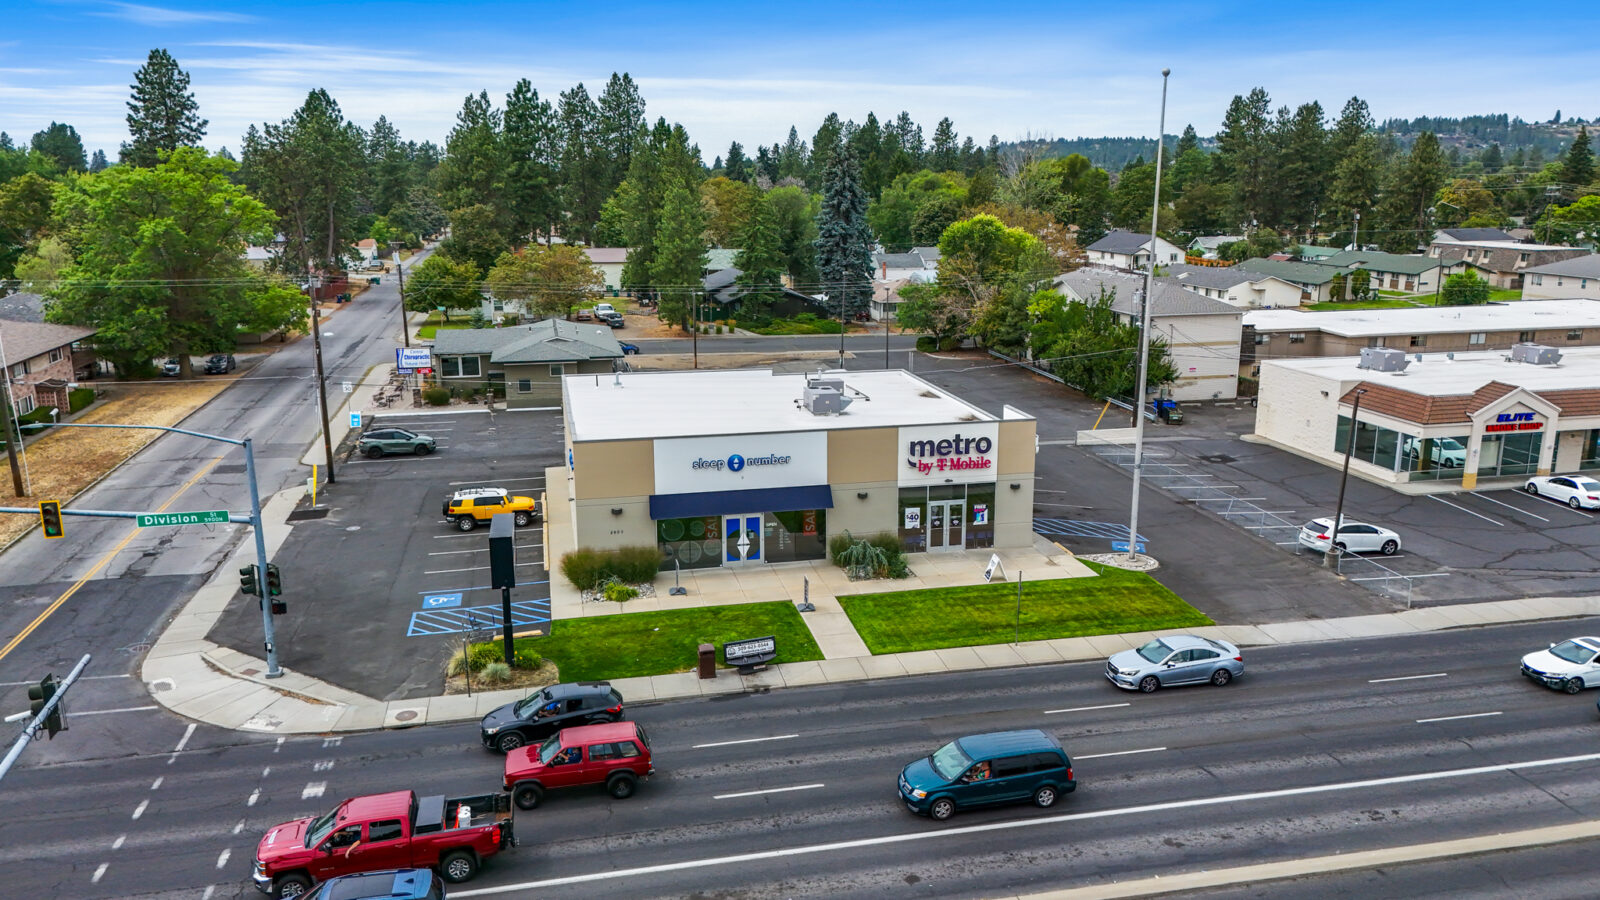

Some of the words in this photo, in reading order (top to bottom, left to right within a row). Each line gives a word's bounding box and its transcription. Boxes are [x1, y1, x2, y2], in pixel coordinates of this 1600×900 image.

[1496, 412, 1536, 422] ELITE
[910, 434, 992, 457] metro
[692, 458, 725, 471] sleep
[747, 454, 791, 466] number
[918, 460, 933, 475] by
[144, 515, 198, 525] Division
